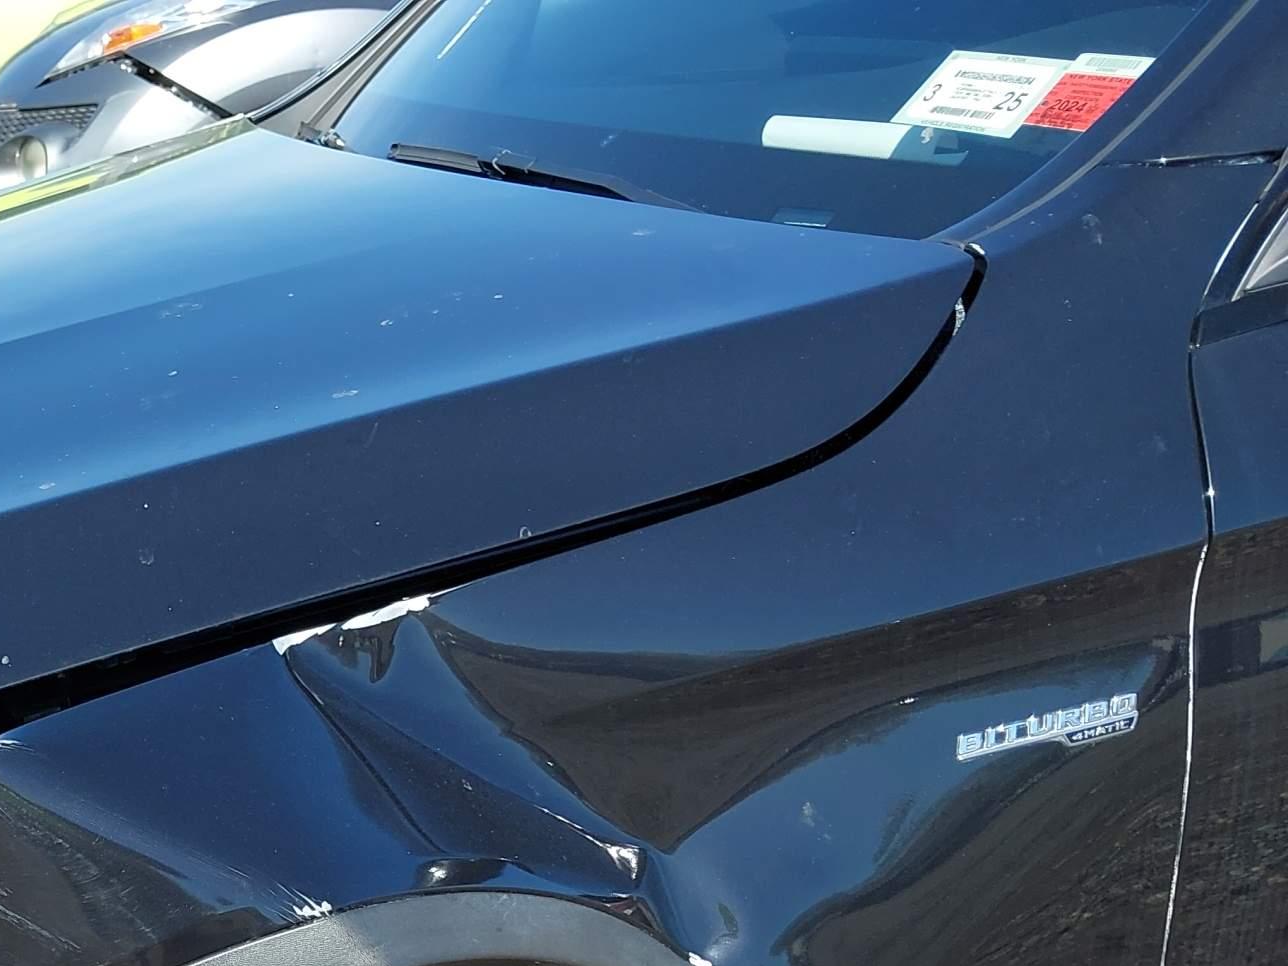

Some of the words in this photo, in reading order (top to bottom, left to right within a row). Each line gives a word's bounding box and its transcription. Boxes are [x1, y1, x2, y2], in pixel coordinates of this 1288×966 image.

[923, 83, 942, 102] 3
[992, 91, 1028, 111] 25
[1050, 98, 1088, 113] 2024
[956, 693, 1137, 757] BITURBO
[1072, 720, 1131, 742] 4MATIC
